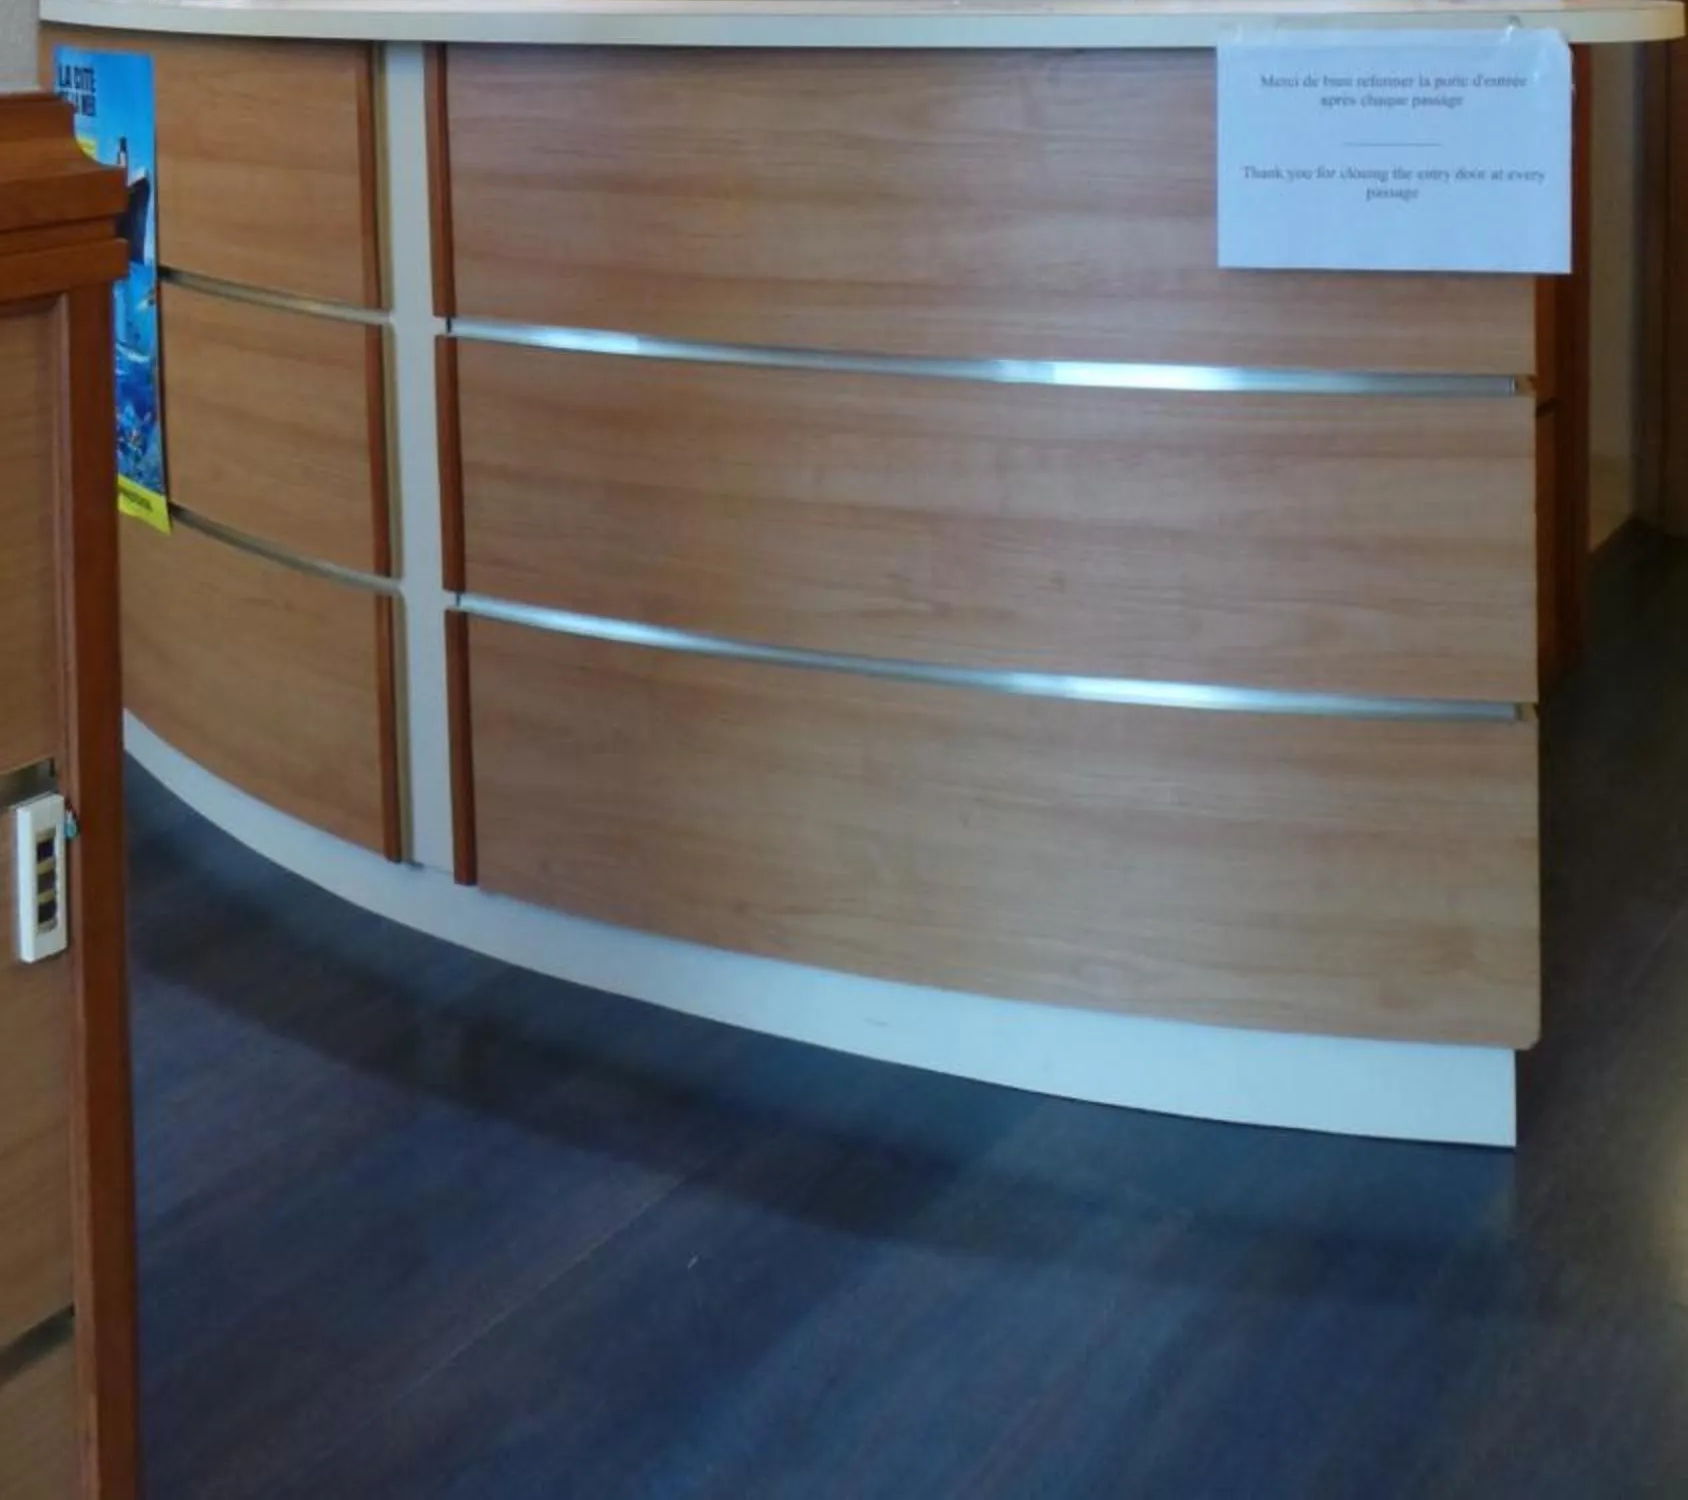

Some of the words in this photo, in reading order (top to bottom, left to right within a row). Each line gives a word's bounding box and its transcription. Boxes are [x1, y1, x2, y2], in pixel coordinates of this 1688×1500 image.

[1302, 76, 1320, 88] de
[1242, 165, 1285, 181] Thank
[1287, 168, 1312, 183] you
[1315, 166, 1337, 181] for
[1392, 168, 1414, 181] the
